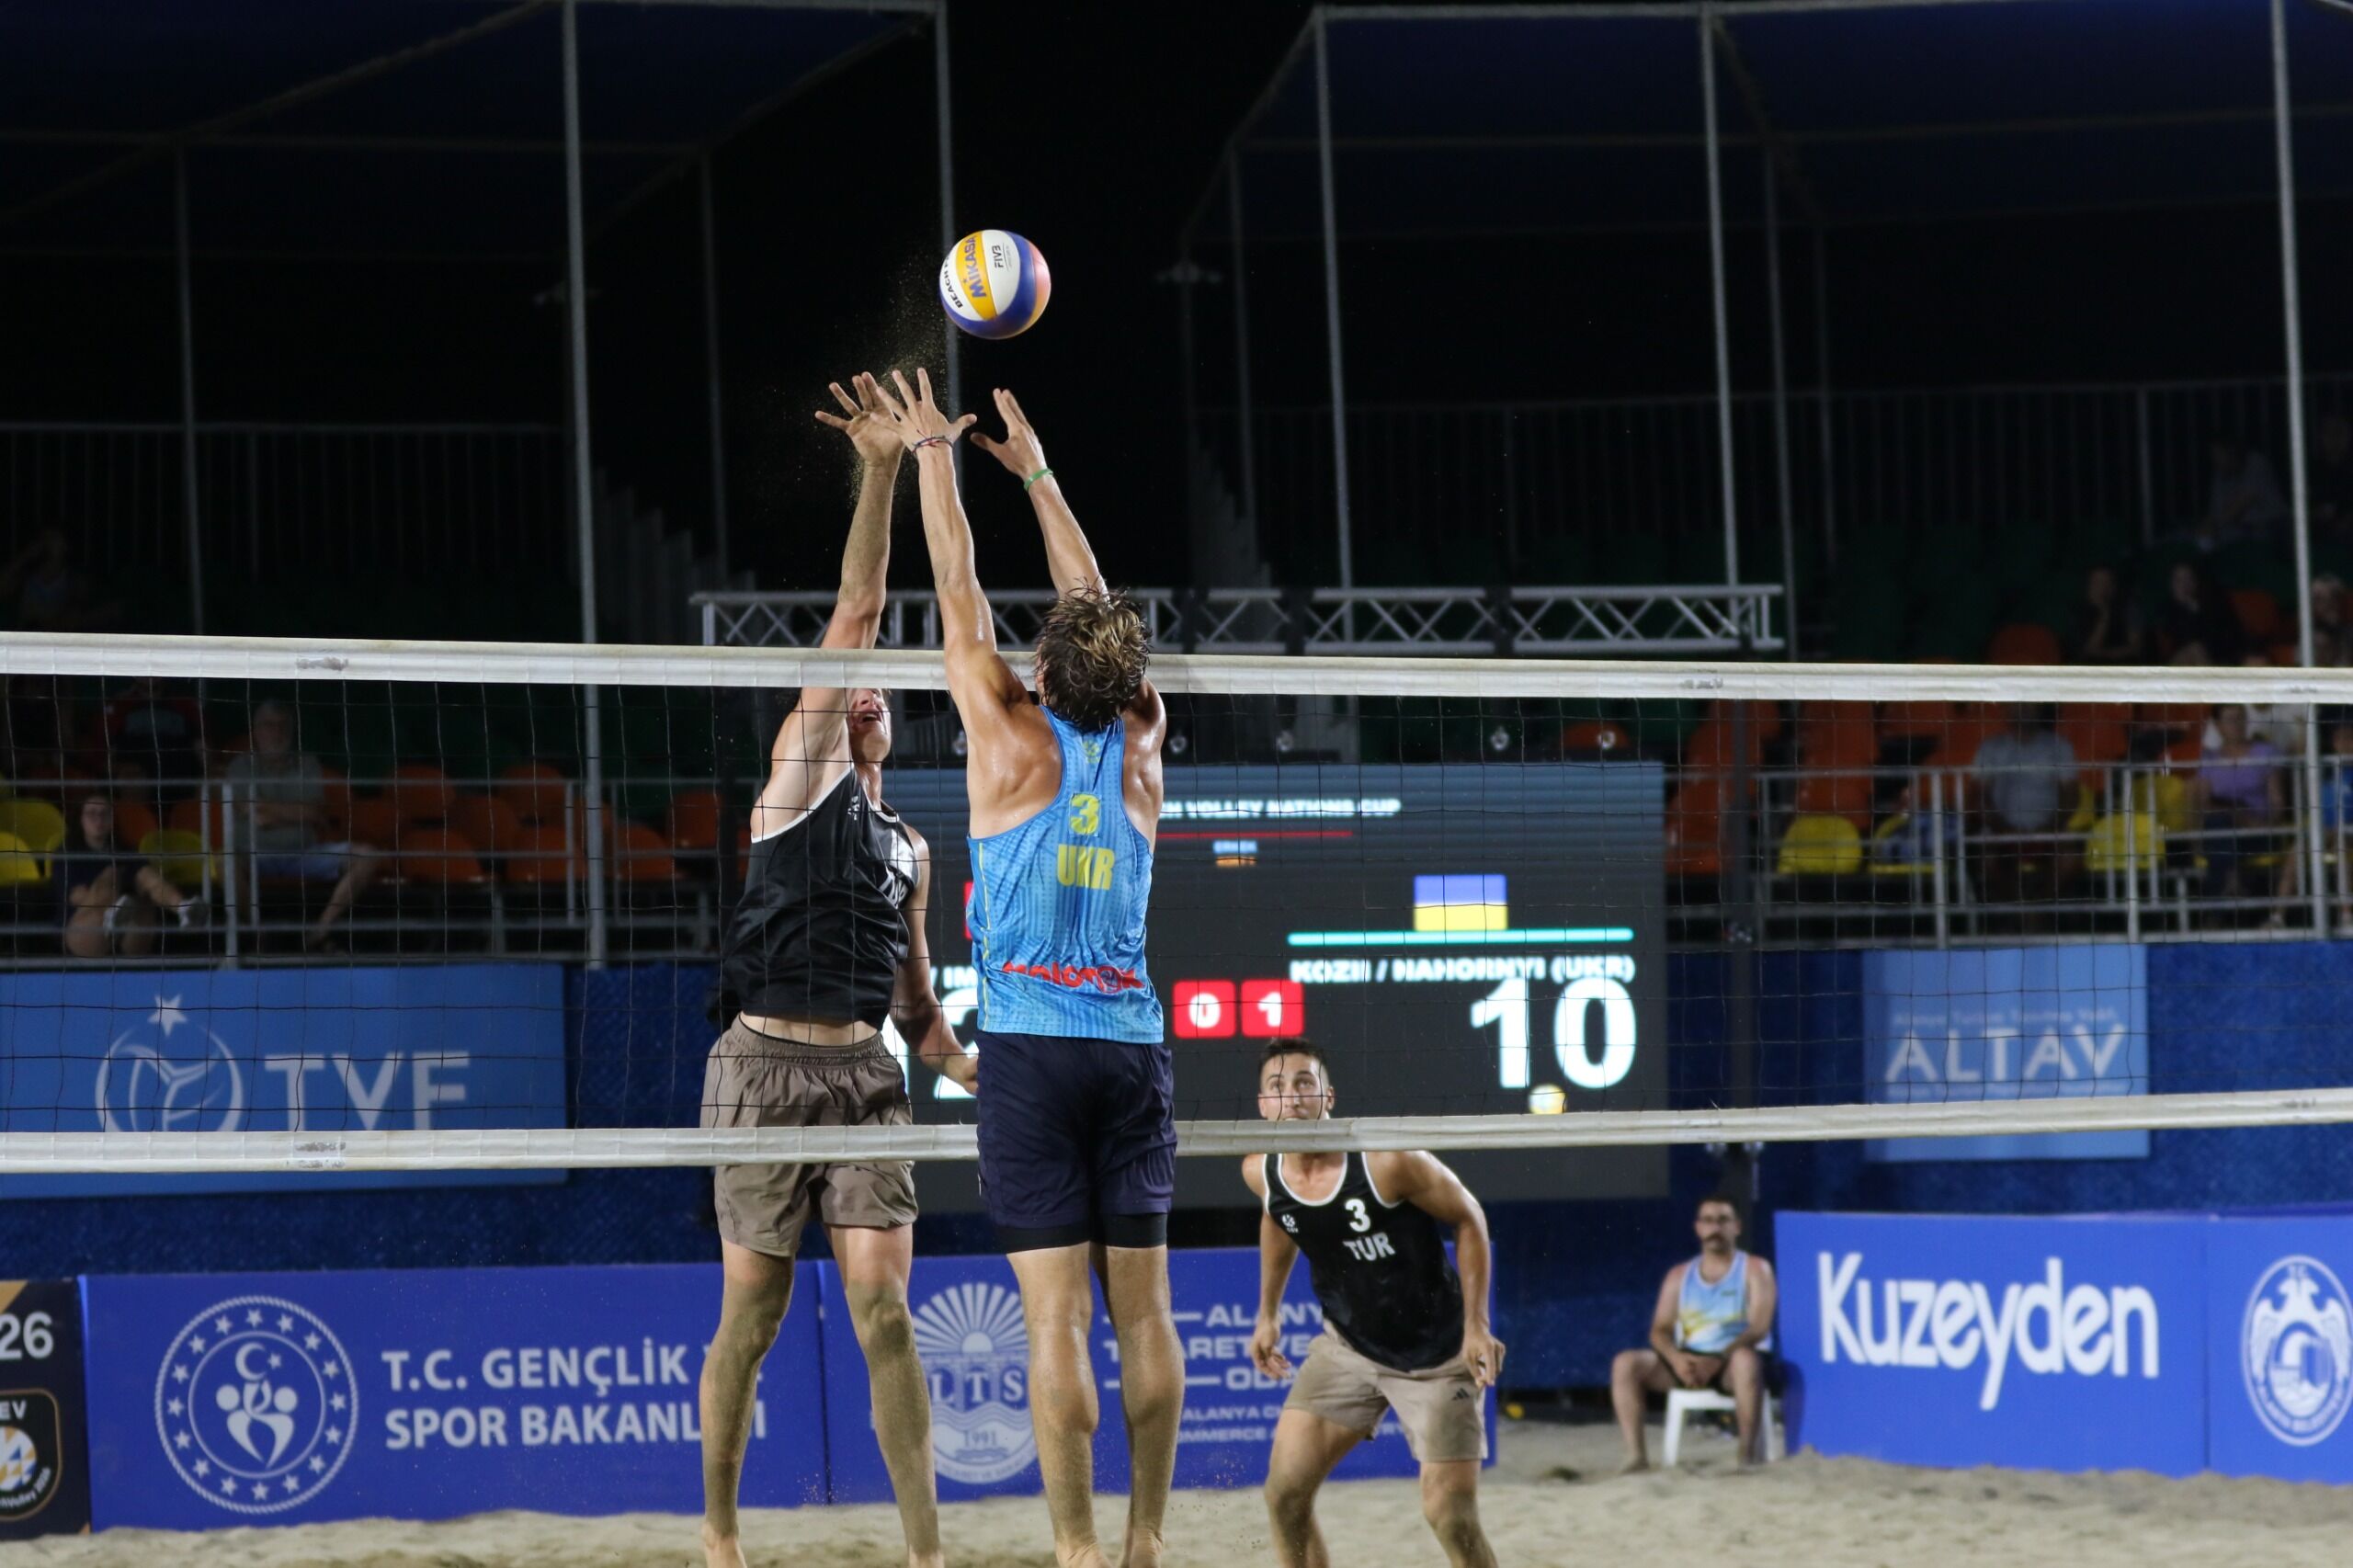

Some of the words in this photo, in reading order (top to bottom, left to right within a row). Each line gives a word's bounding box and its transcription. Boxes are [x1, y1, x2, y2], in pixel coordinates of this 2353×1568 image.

[992, 244, 1004, 268] FIVB
[942, 270, 963, 309] BEACH
[1070, 793, 1101, 835] 3
[1186, 800, 1264, 819] VOLLEY
[1358, 798, 1402, 817] CUP
[1058, 844, 1115, 891] UKR
[1550, 954, 1636, 983] (UKR)
[1189, 994, 1221, 1029] 0
[1257, 993, 1282, 1027] 1
[1471, 976, 1637, 1088] 10
[1885, 1022, 2127, 1083] ALTAV
[265, 1051, 470, 1131] TVF
[1345, 1199, 1371, 1233] 3
[1342, 1233, 1396, 1262] TUR
[1206, 1301, 1324, 1328] ALNY
[1818, 1251, 2159, 1412] Kuzeyden
[381, 1349, 468, 1391] T.C.
[481, 1337, 689, 1397] GENÇLİK
[930, 1367, 1025, 1404] LTS
[384, 1405, 508, 1449] SPOR
[520, 1400, 766, 1447] BAKANLI
[1181, 1405, 1260, 1421] ALANYA
[965, 1430, 998, 1449] 1991
[1177, 1426, 1267, 1443] OMMERCE
